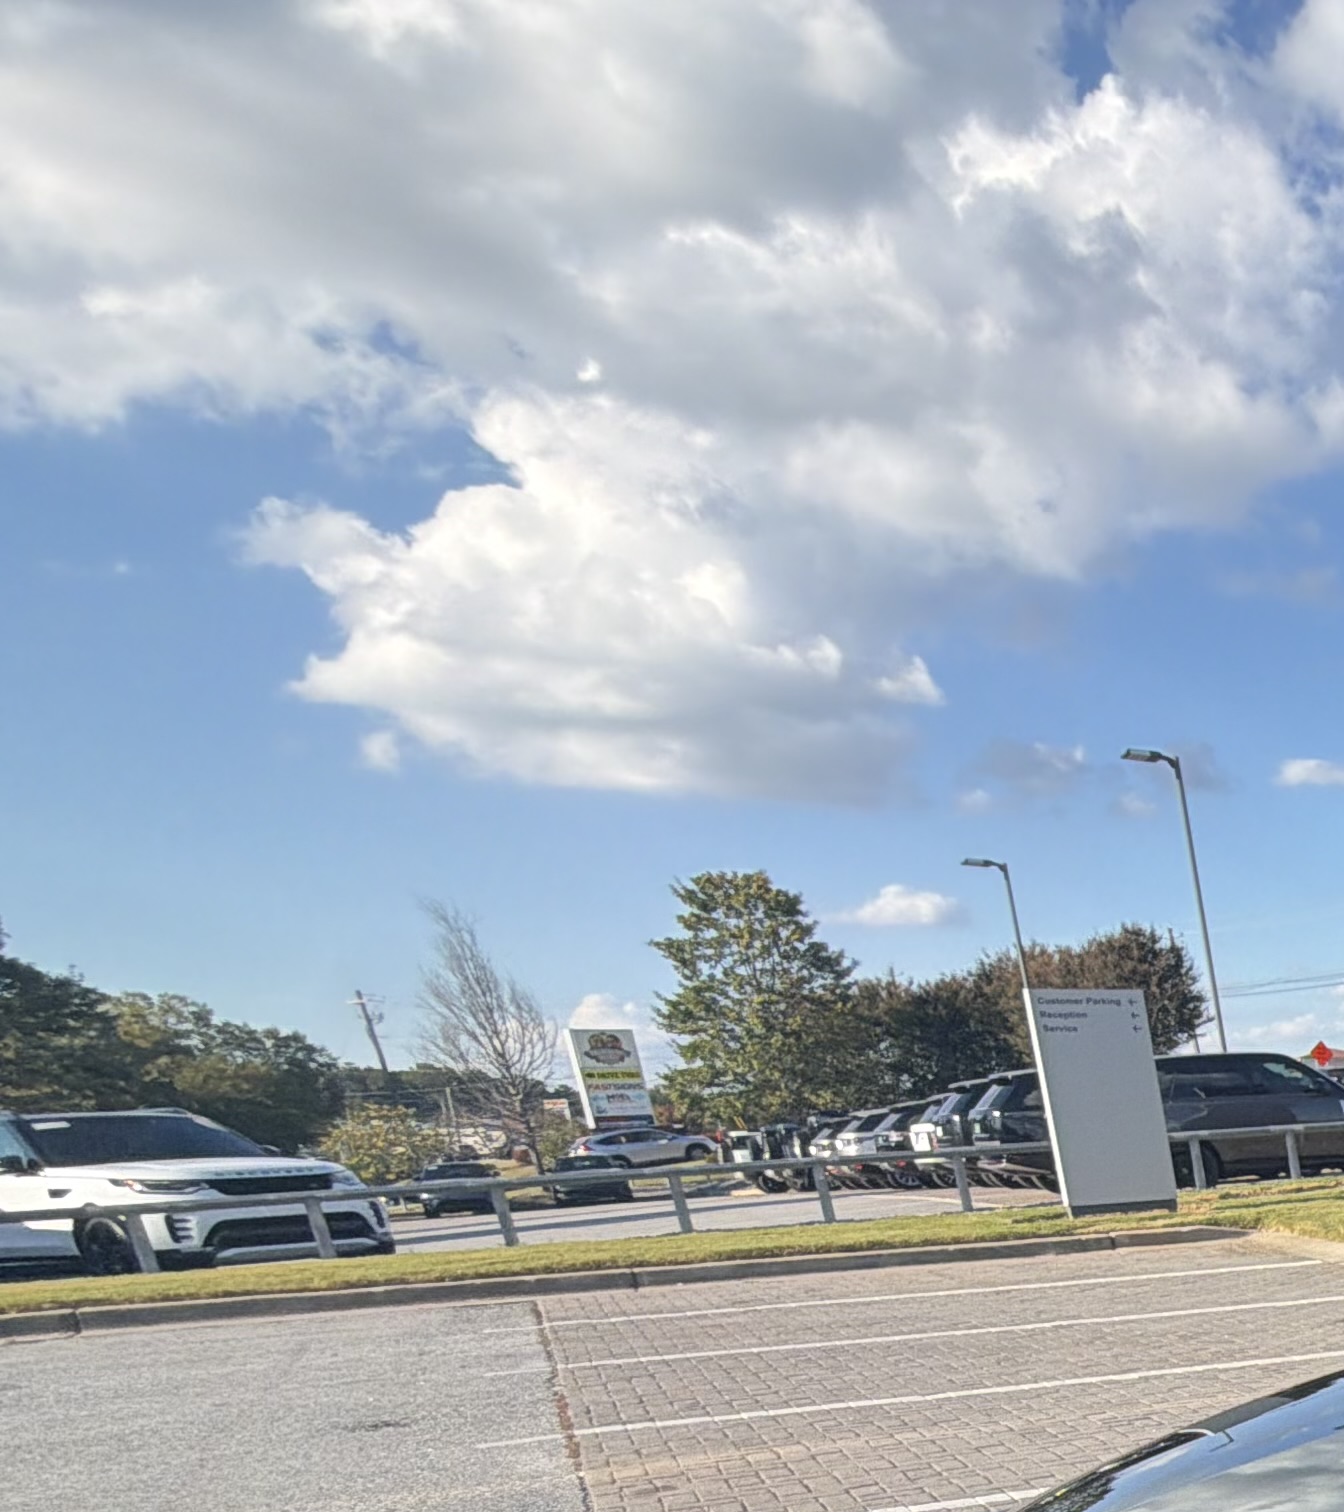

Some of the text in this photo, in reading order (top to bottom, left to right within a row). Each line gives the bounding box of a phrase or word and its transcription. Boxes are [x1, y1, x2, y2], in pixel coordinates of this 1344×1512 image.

[1037, 997, 1121, 1007] Customer Parking
[1040, 1010, 1087, 1020] Reception
[1042, 1024, 1078, 1032] Service
